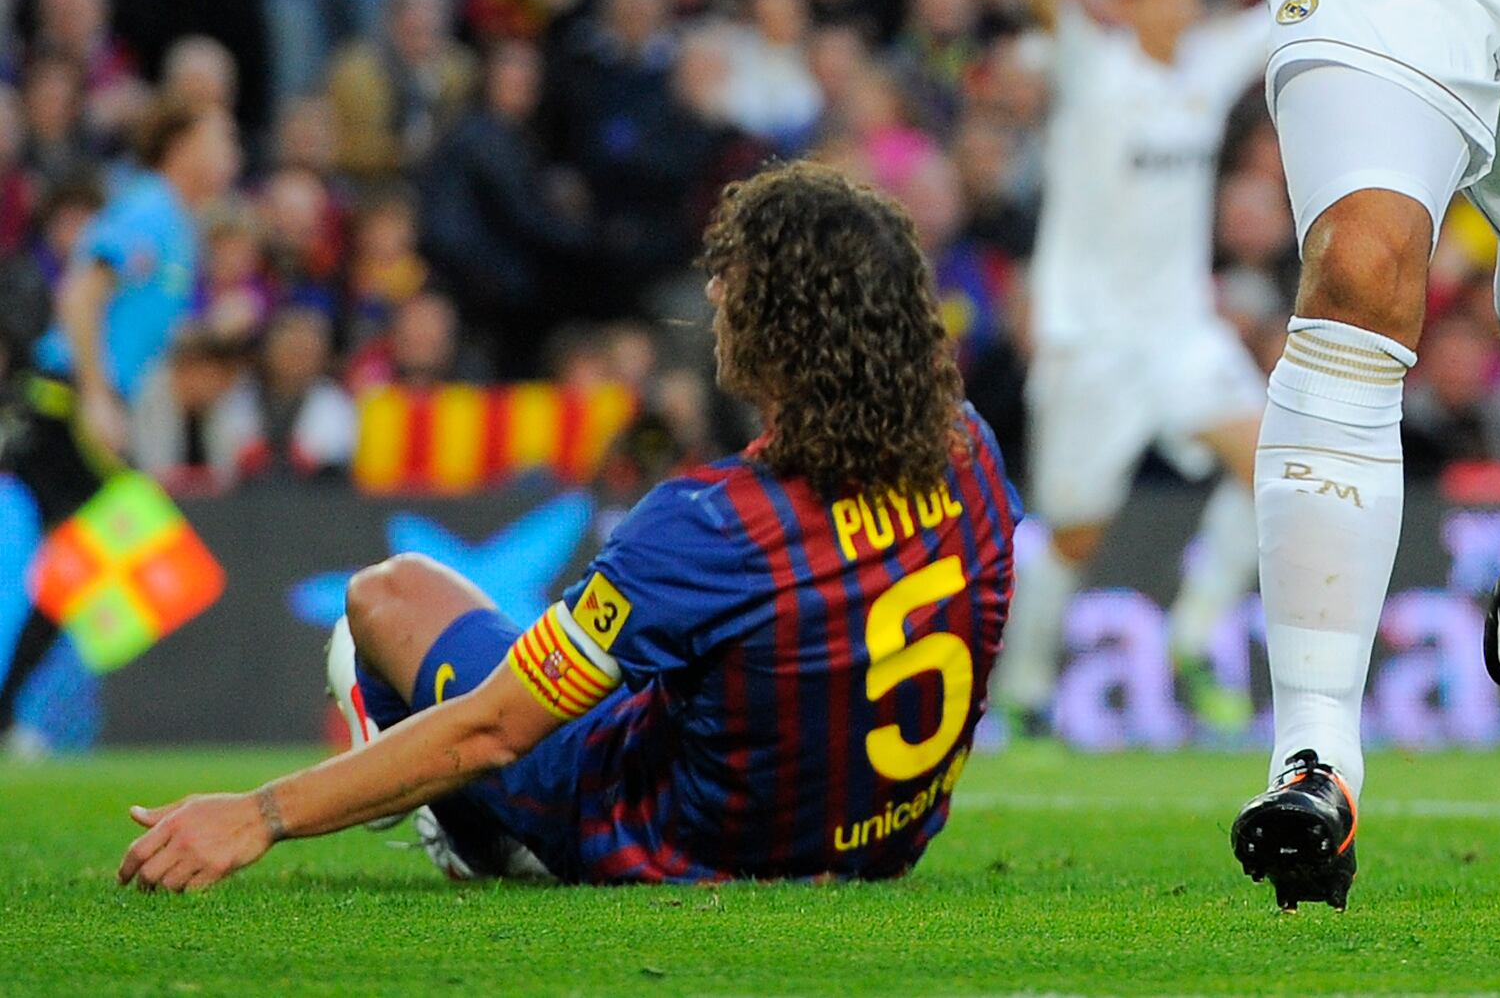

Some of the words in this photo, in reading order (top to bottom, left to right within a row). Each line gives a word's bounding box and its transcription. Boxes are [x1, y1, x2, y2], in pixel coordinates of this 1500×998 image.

[832, 487, 962, 561] PUYOL
[594, 602, 618, 633] 3
[866, 555, 972, 780] 5
